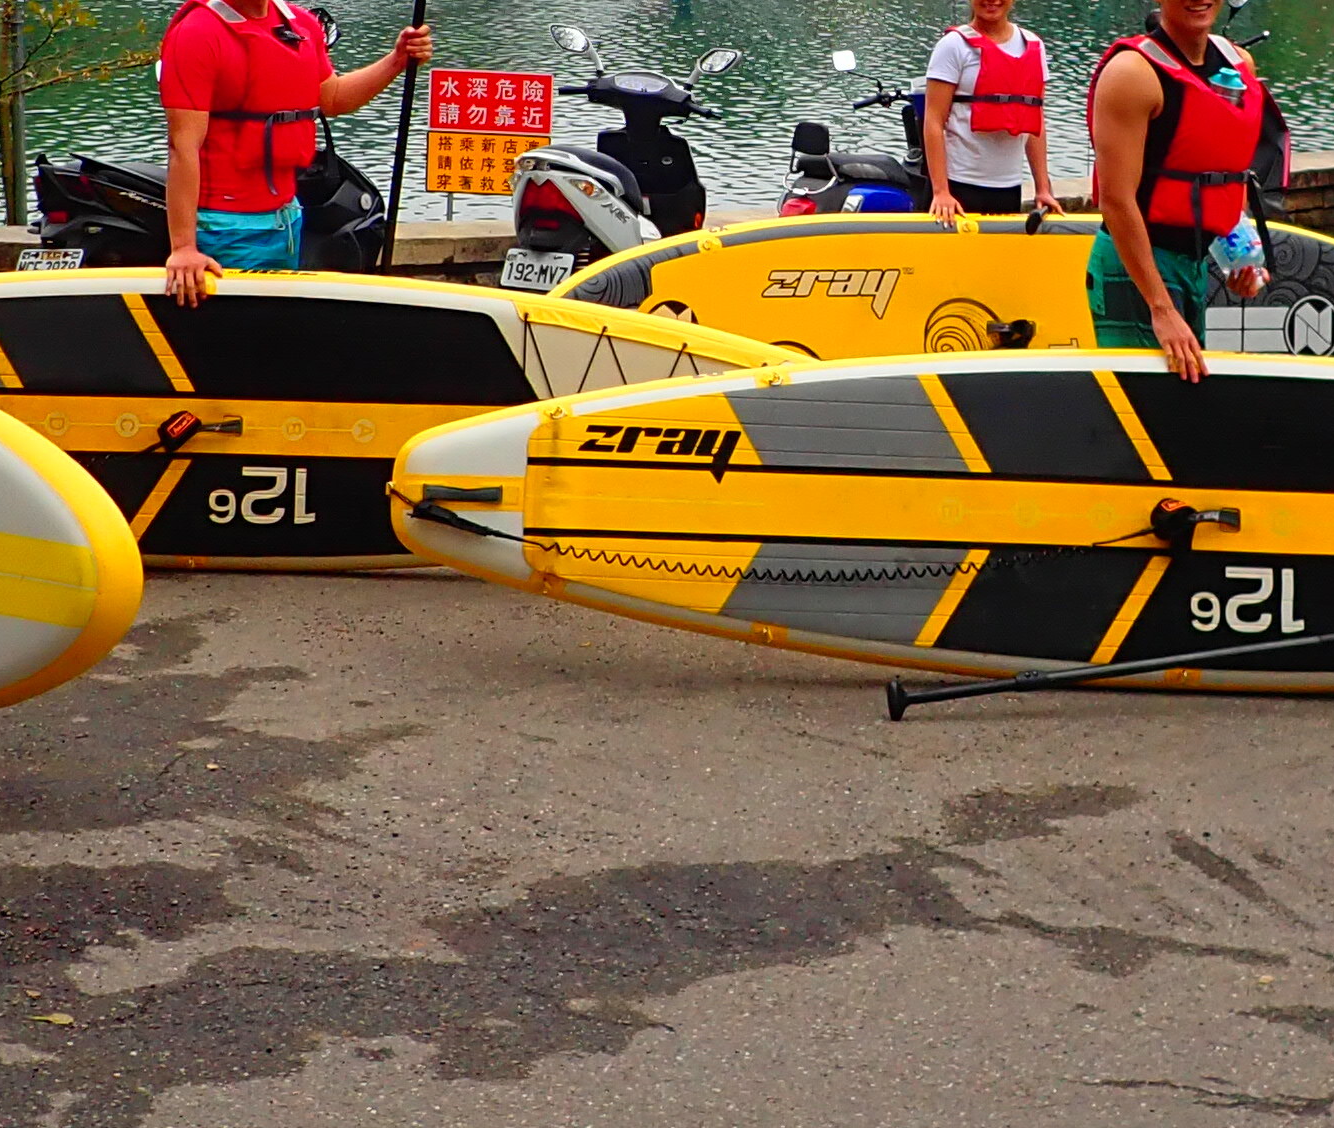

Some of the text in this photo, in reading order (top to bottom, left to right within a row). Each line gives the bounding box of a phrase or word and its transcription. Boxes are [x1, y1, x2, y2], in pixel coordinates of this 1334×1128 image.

[438, 76, 545, 103] 水深危險
[437, 102, 545, 129] 請勿靠近
[761, 268, 901, 320] zray
[577, 424, 742, 485] zray
